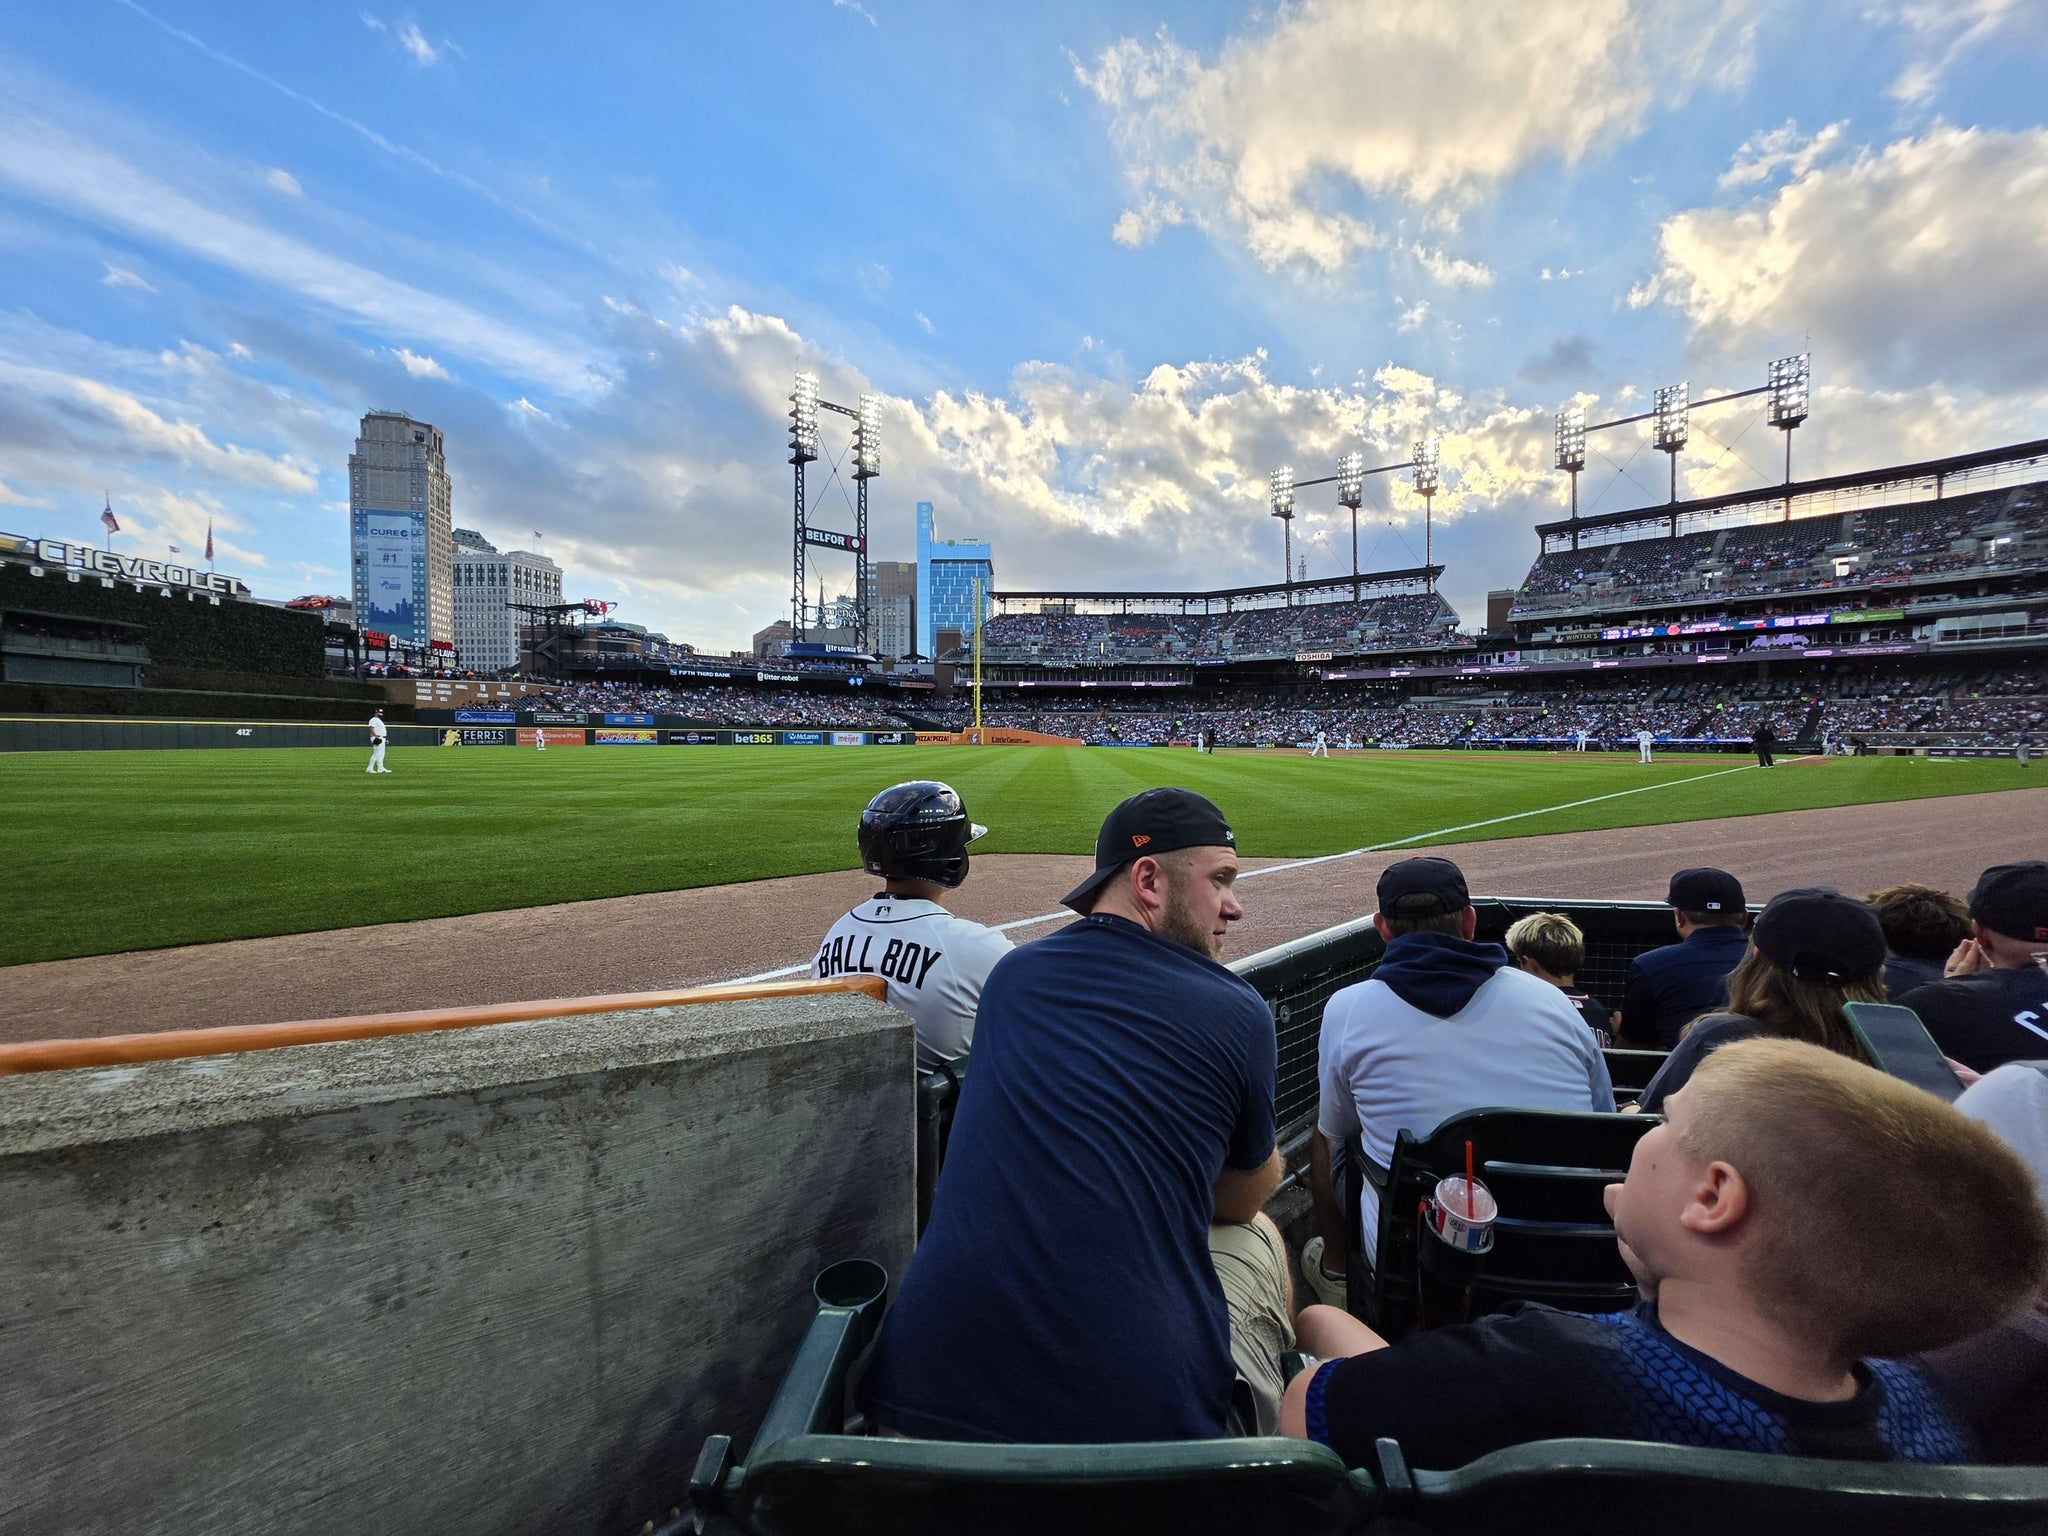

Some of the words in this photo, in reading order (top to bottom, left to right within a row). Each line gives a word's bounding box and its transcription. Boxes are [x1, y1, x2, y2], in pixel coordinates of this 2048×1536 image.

[371, 528, 399, 537] CURE
[806, 530, 845, 546] BELFOR
[383, 553, 397, 563] #1
[38, 540, 242, 595] CHEVROLET
[1565, 633, 1598, 641] WINTER'S
[1296, 652, 1331, 661] TOSHIBA
[764, 673, 799, 682] Litter-robot
[464, 730, 504, 740] FERRIS
[601, 732, 634, 742] Surfside
[735, 733, 773, 743] bet365
[838, 734, 859, 744] meijer
[820, 935, 874, 978] BALL
[881, 938, 943, 990] BOY
